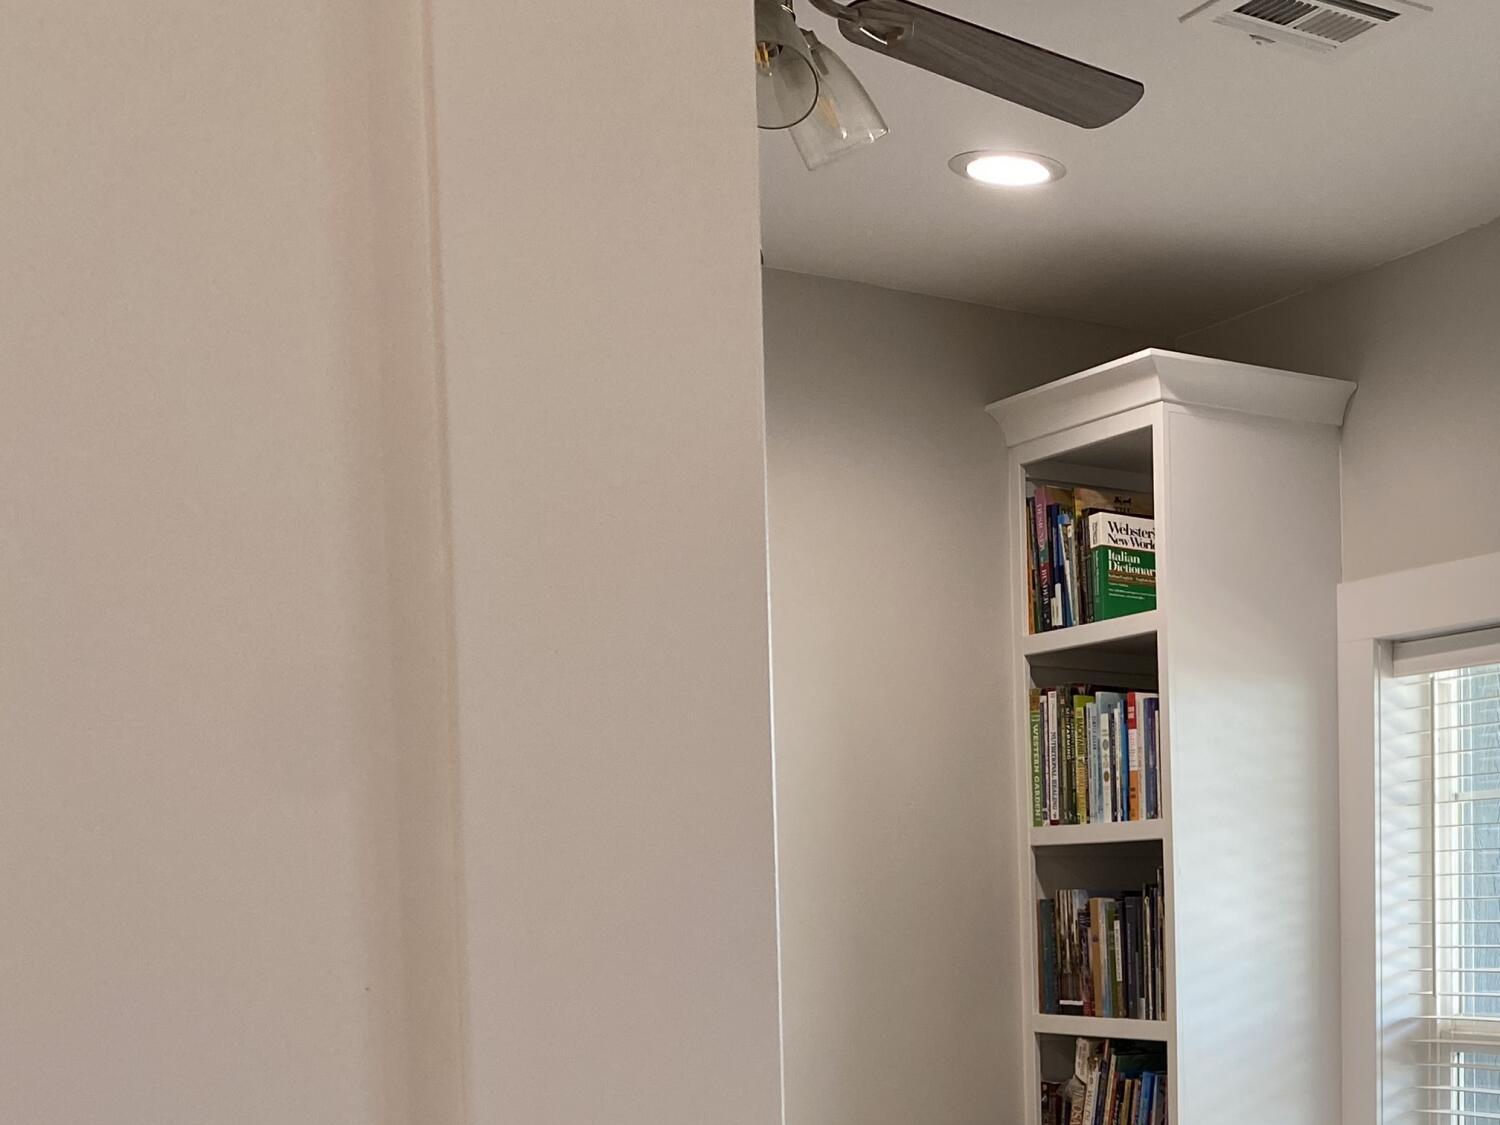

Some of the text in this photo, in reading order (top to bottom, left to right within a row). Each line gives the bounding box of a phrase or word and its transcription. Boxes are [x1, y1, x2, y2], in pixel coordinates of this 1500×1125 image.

[1107, 533, 1129, 545] New
[1108, 549, 1141, 565] Italian
[1107, 560, 1156, 577] Dictionar
[1076, 717, 1084, 757] BACKYARD
[1033, 724, 1043, 817] WESTERN GARDEN
